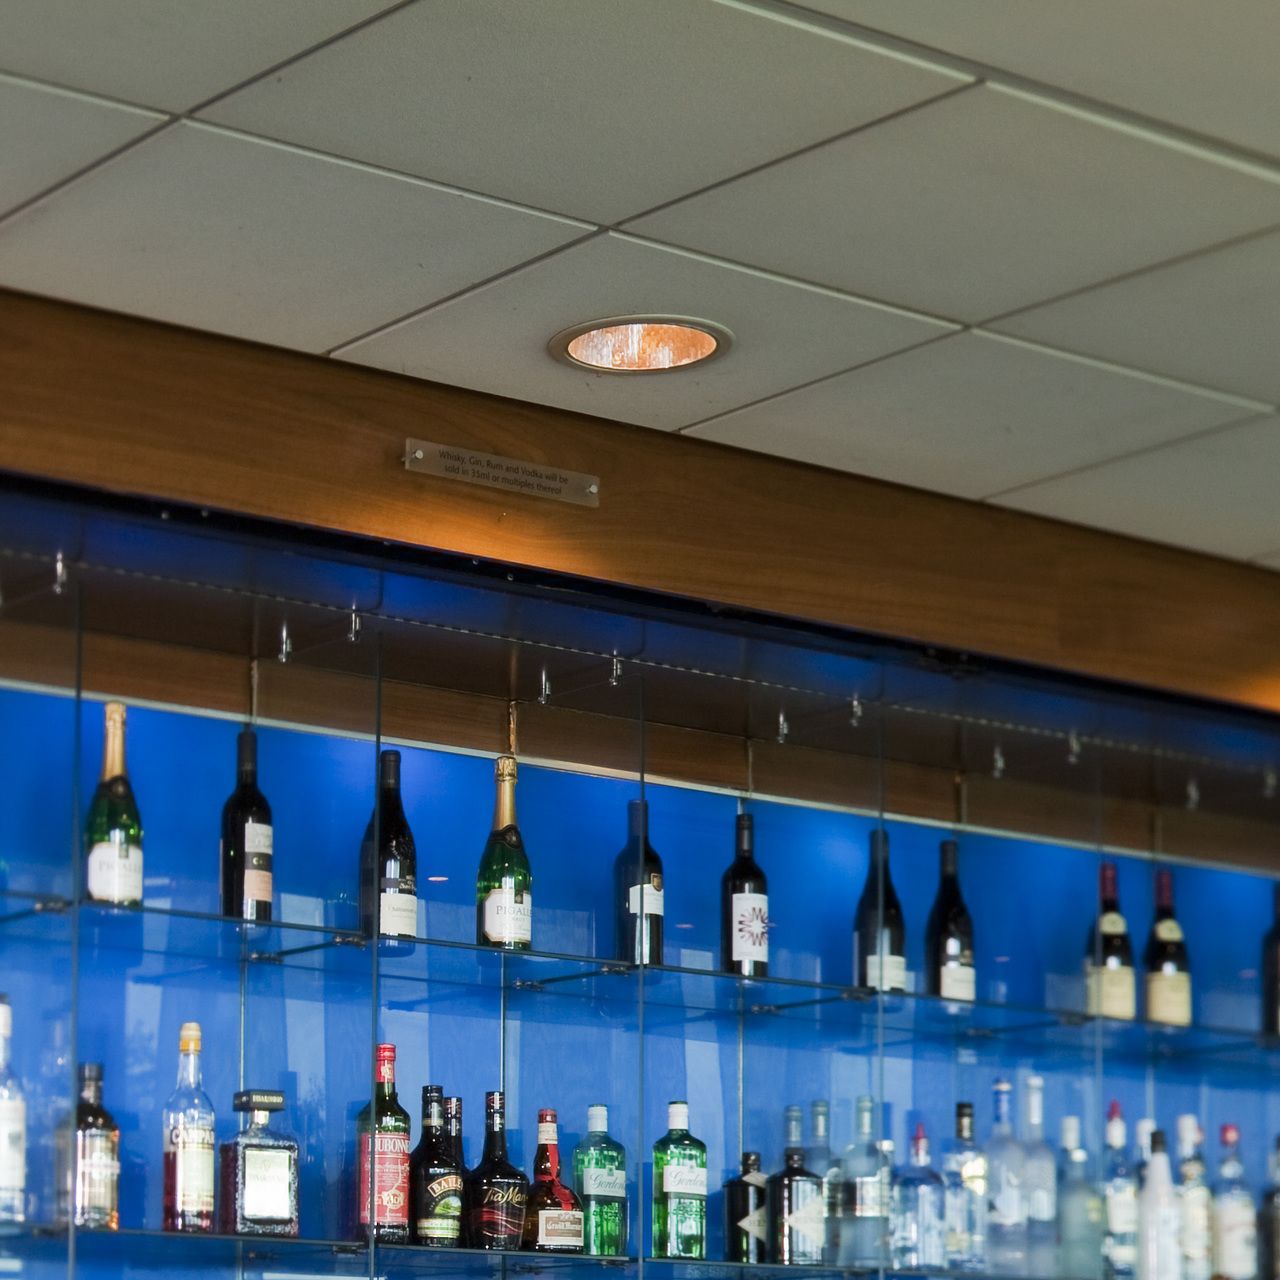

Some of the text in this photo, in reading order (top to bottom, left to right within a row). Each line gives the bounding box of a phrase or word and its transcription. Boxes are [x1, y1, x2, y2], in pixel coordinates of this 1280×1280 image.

[438, 449, 568, 484] Whisky, Gin, Rum and Vodka will be
[444, 464, 460, 474] sold
[461, 466, 469, 475] in
[471, 469, 490, 481] 35ml
[501, 476, 535, 490] multiples
[431, 1177, 462, 1193] BAILE
[482, 1186, 504, 1204] Tia
